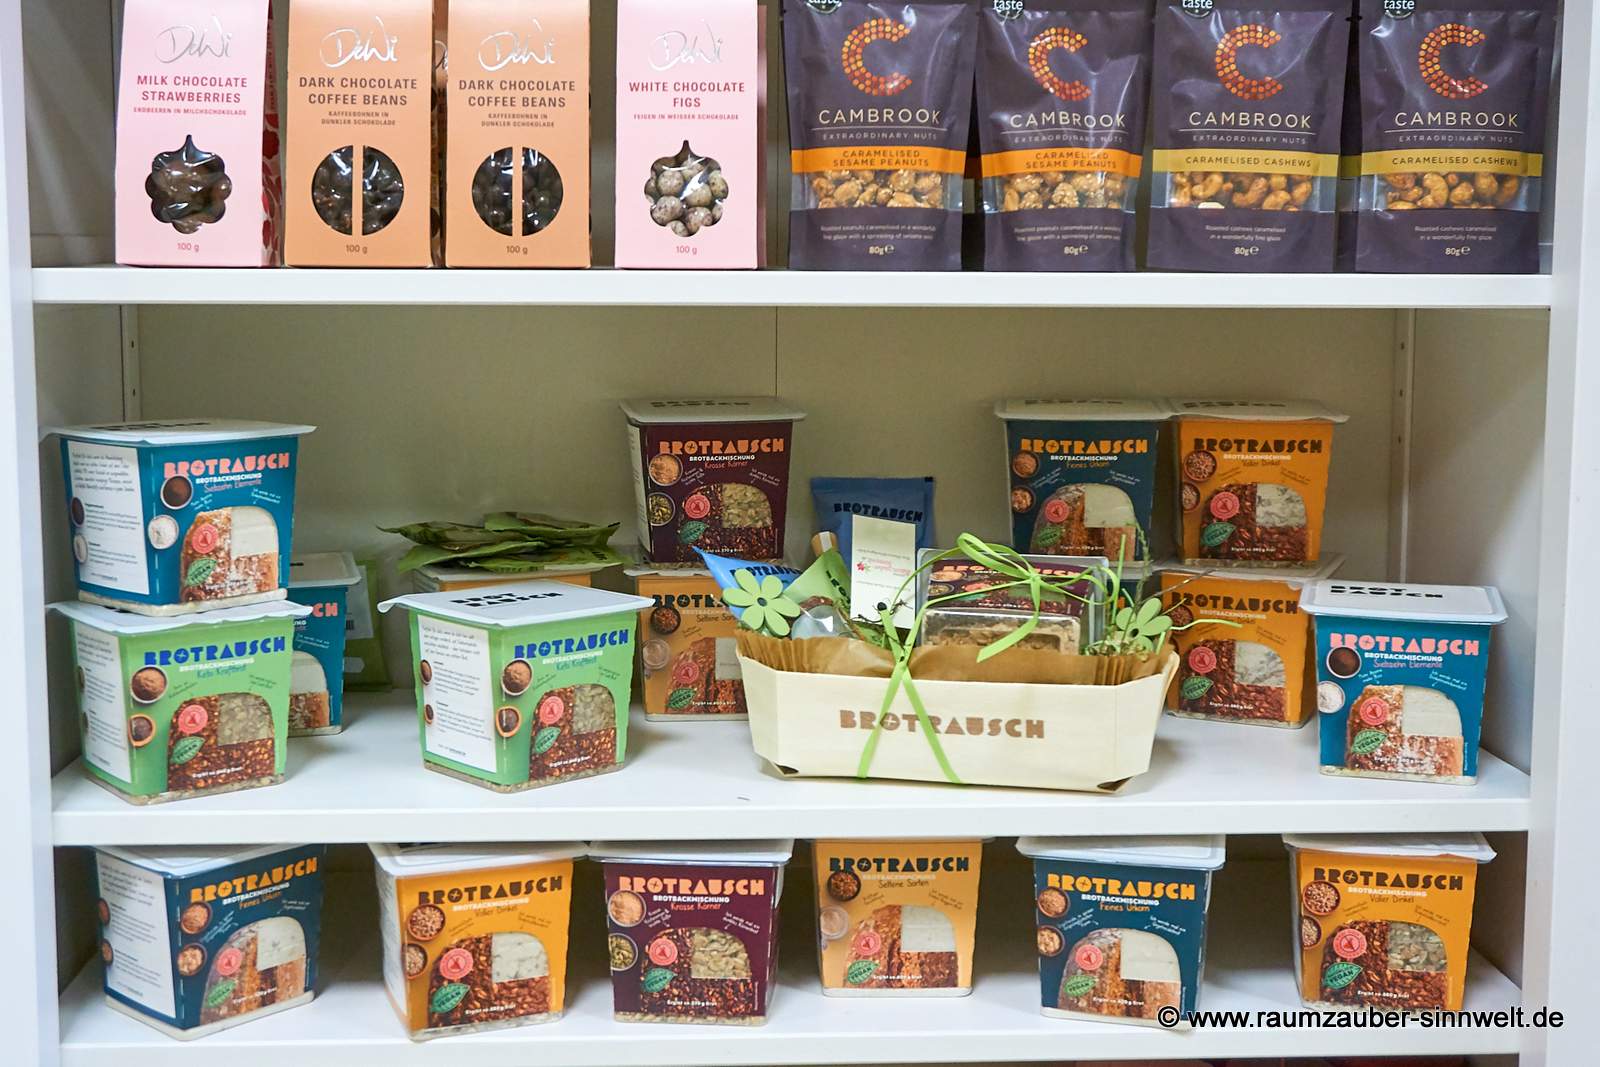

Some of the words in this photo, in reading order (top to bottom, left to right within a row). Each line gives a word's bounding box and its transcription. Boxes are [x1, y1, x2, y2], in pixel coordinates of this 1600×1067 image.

[137, 75, 168, 86] MILK
[173, 75, 248, 88] CHOCOLATE
[299, 76, 335, 88] DARK
[340, 77, 417, 90] CHOCOLATE
[459, 79, 494, 91] DARK
[499, 80, 576, 91] CHOCOLATE
[629, 81, 669, 92] WHITE
[673, 81, 745, 92] CHOCOLATE
[141, 90, 241, 103] STRAWBERRIES
[308, 93, 357, 105] COFFEE
[362, 95, 408, 106] BEANS
[468, 96, 516, 107] COFFEE
[521, 97, 566, 108] BEANS
[673, 97, 701, 108] FIGS
[819, 108, 941, 124] CAMBROOK
[1010, 111, 1126, 128] CAMBROOK
[1189, 111, 1312, 129] CAMBROOK
[1395, 111, 1518, 127] CAMBROOK
[823, 132, 908, 141] EXTRAORDINARY
[1193, 134, 1277, 144] EXTRAORDINARY
[1282, 137, 1306, 145] NUTS
[1490, 136, 1513, 144] NUTS
[842, 150, 920, 159] CARAMELISED
[1392, 156, 1469, 165] CARAMELISED
[1473, 156, 1518, 167] CASHEWS
[833, 159, 875, 168] SESAME
[880, 158, 929, 167] PEANUTS
[1025, 160, 1068, 170] SESAME
[1185, 156, 1260, 165] CARAMELISED
[1264, 157, 1311, 168] CASHEWS
[177, 243, 191, 251] 100
[194, 244, 199, 253] g
[345, 245, 360, 253] 100
[362, 246, 368, 255] g
[506, 246, 520, 254] 100
[522, 247, 528, 255] g
[676, 246, 690, 254] 100
[693, 247, 697, 255] g
[659, 438, 784, 455] BROTRAUSCH
[1020, 438, 1148, 454] BROTRAUSCH
[1194, 438, 1322, 453] BROTRAUSCH
[164, 452, 289, 480] BROTRAUSCH
[834, 503, 923, 522] BROTRAUSCH
[1172, 591, 1298, 614] BROTRAUSCH
[144, 636, 286, 666] BROTRAUSCH
[514, 629, 628, 660] BROTRAUSCH
[1330, 632, 1480, 656] BROTRAUSCH
[1364, 652, 1443, 662] BROTBACKMISCHUNG
[839, 709, 1046, 739] BROTRAUSCH
[830, 857, 969, 873] BROTRAUSCH
[190, 857, 318, 903] BROTRAUSCH
[619, 876, 764, 895] BROTRAUSCH
[1314, 867, 1463, 890] BROTRAUSCH
[418, 875, 562, 905] BROTRAUSCH
[1047, 873, 1196, 900] BROTRAUSCH
[653, 895, 730, 903] BROTBACKMISCHUNG
[1329, 969, 1354, 983] VEGAN
